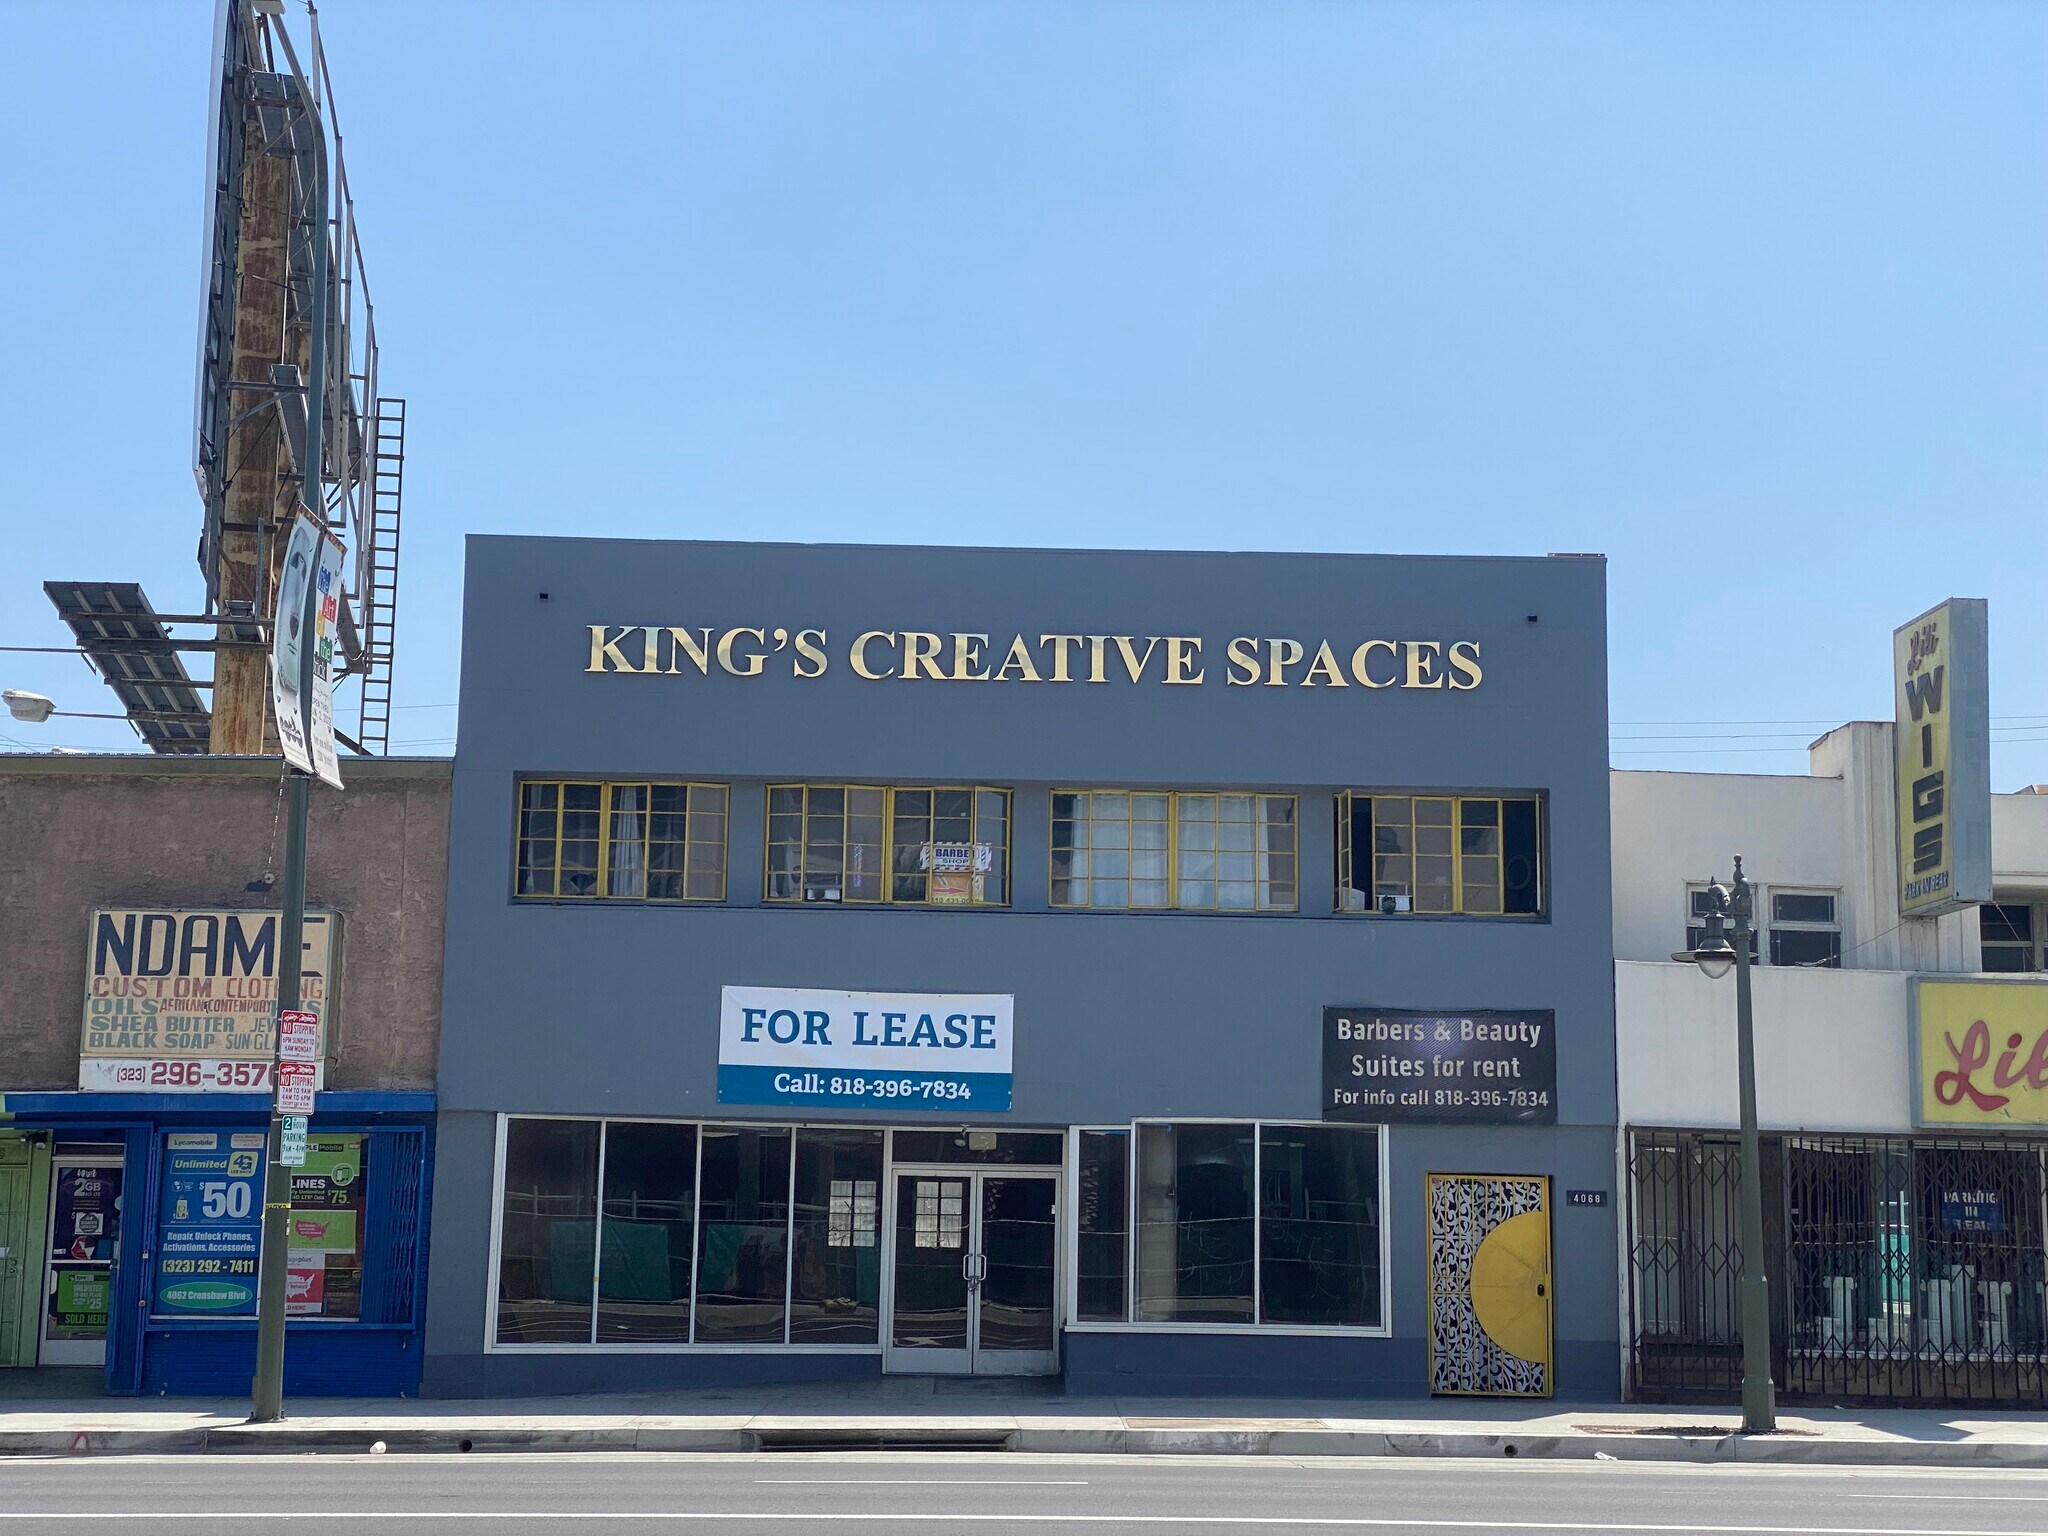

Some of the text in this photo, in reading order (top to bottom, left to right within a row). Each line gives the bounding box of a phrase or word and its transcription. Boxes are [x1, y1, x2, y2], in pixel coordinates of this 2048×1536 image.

[584, 624, 1482, 690] KING'S CREATIVE SPACES
[935, 848, 970, 858] BARBE
[93, 976, 213, 998] CUSTOM
[91, 997, 159, 1016] OILS
[90, 1015, 158, 1032] SHEA
[166, 1016, 235, 1033] BUTTER
[282, 1021, 316, 1036] NO STOPPING
[741, 1007, 997, 1050] FOR LEASE
[89, 1032, 158, 1048] BLACK
[164, 1032, 215, 1049] SOAP
[1337, 1018, 1542, 1048] Barbers & Beauty
[1351, 1054, 1521, 1078] Suites for rent
[280, 1074, 313, 1087] NO STOPPING
[773, 1072, 971, 1100] Call: 818-396-7834
[1333, 1088, 1549, 1107] For info call 818-396-7834
[284, 1117, 292, 1129] 2
[174, 1139, 214, 1147] Lycamobile
[283, 1132, 306, 1142] PARKING
[174, 1154, 253, 1171] Unlimited 4G
[1573, 1193, 1601, 1204] 4068
[167, 1232, 253, 1242] Repair, Unlock Phones,
[162, 1243, 256, 1252] Activations, Accessories
[188, 1291, 228, 1300] Crenshaw
[228, 1290, 246, 1300] Blvd
[65, 1313, 107, 1325] SOLD HERE
